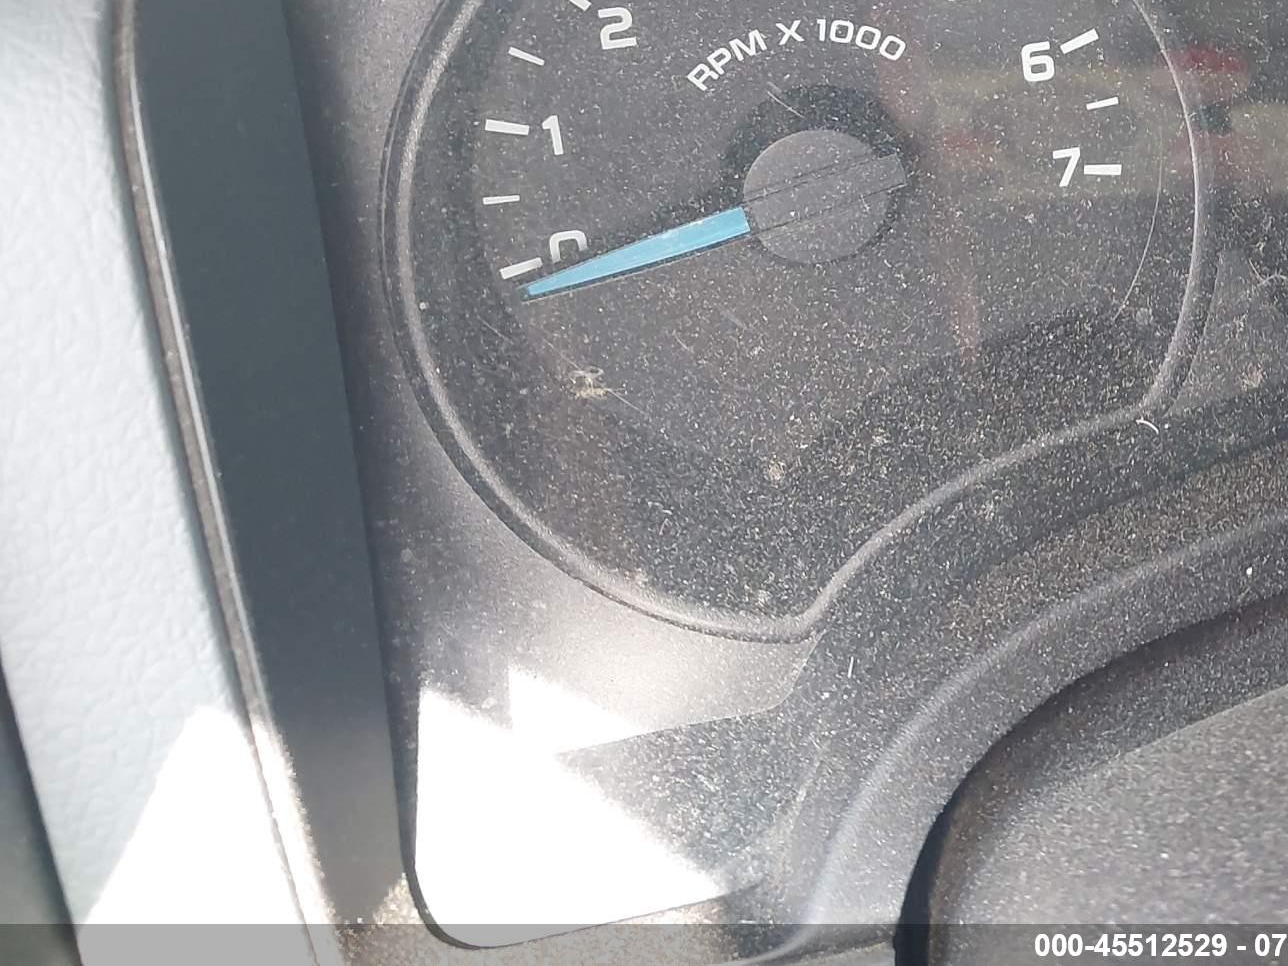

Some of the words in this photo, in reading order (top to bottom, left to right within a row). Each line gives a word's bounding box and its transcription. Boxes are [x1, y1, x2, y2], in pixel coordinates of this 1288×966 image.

[597, 6, 638, 51] 2
[686, 28, 768, 92] RPM
[775, 19, 805, 46] X
[815, 19, 908, 62] 1000
[1020, 40, 1055, 83] 6
[541, 114, 565, 156] 1
[1051, 146, 1083, 188] 7
